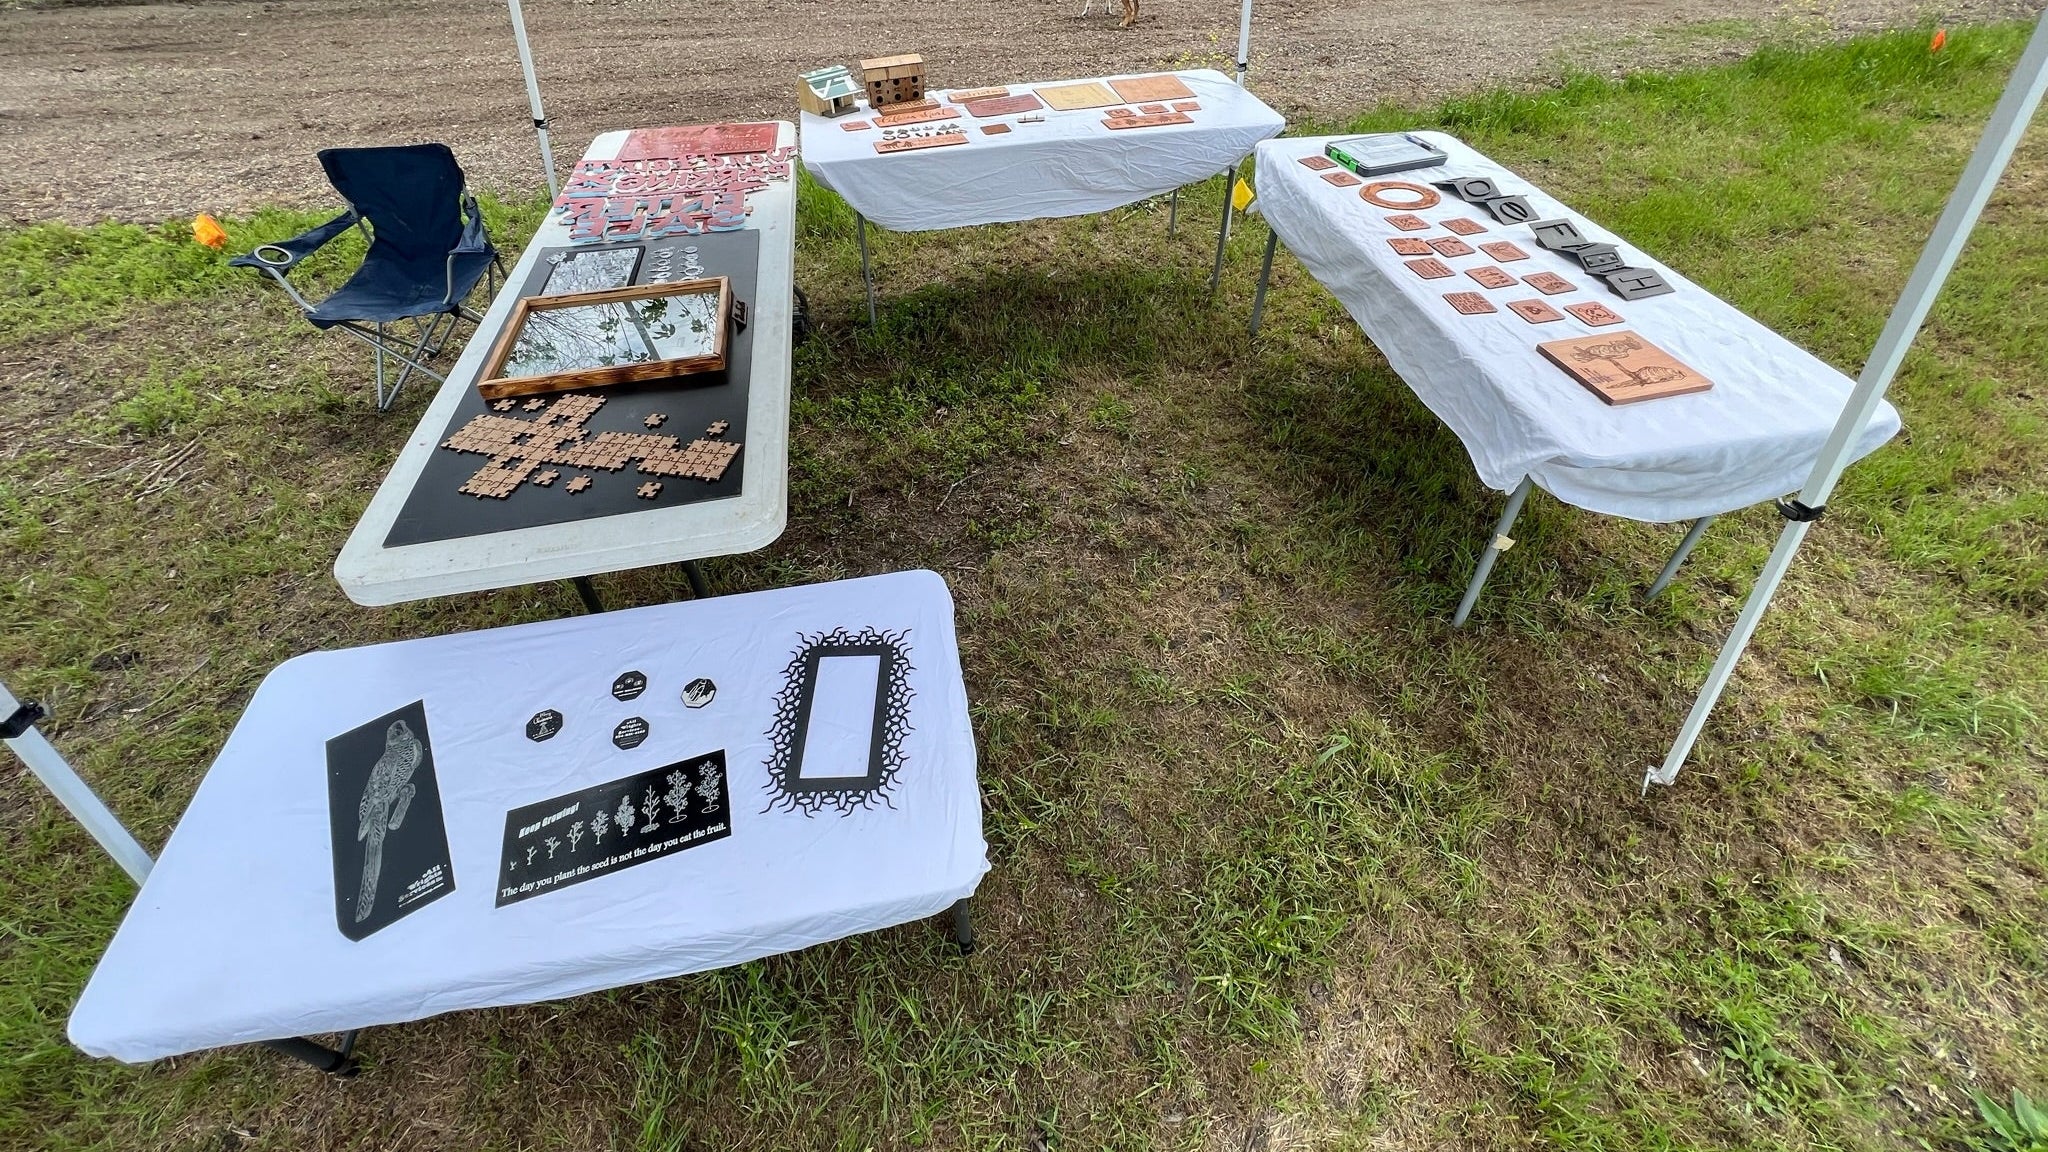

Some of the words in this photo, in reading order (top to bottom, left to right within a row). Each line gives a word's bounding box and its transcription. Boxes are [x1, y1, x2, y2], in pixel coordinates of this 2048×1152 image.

[518, 821, 541, 839] Keep
[541, 801, 580, 828] Growing!
[501, 886, 519, 899] The
[519, 880, 536, 894] day
[537, 875, 553, 890] you
[553, 867, 577, 885] plant
[576, 863, 590, 876] the
[590, 856, 610, 871] seed
[610, 855, 618, 866] is
[618, 850, 633, 864] not
[634, 845, 647, 858] the
[647, 840, 663, 854] day
[663, 836, 679, 850] you
[679, 832, 693, 844] eat
[693, 827, 706, 840] the
[706, 822, 727, 837] fruit.
